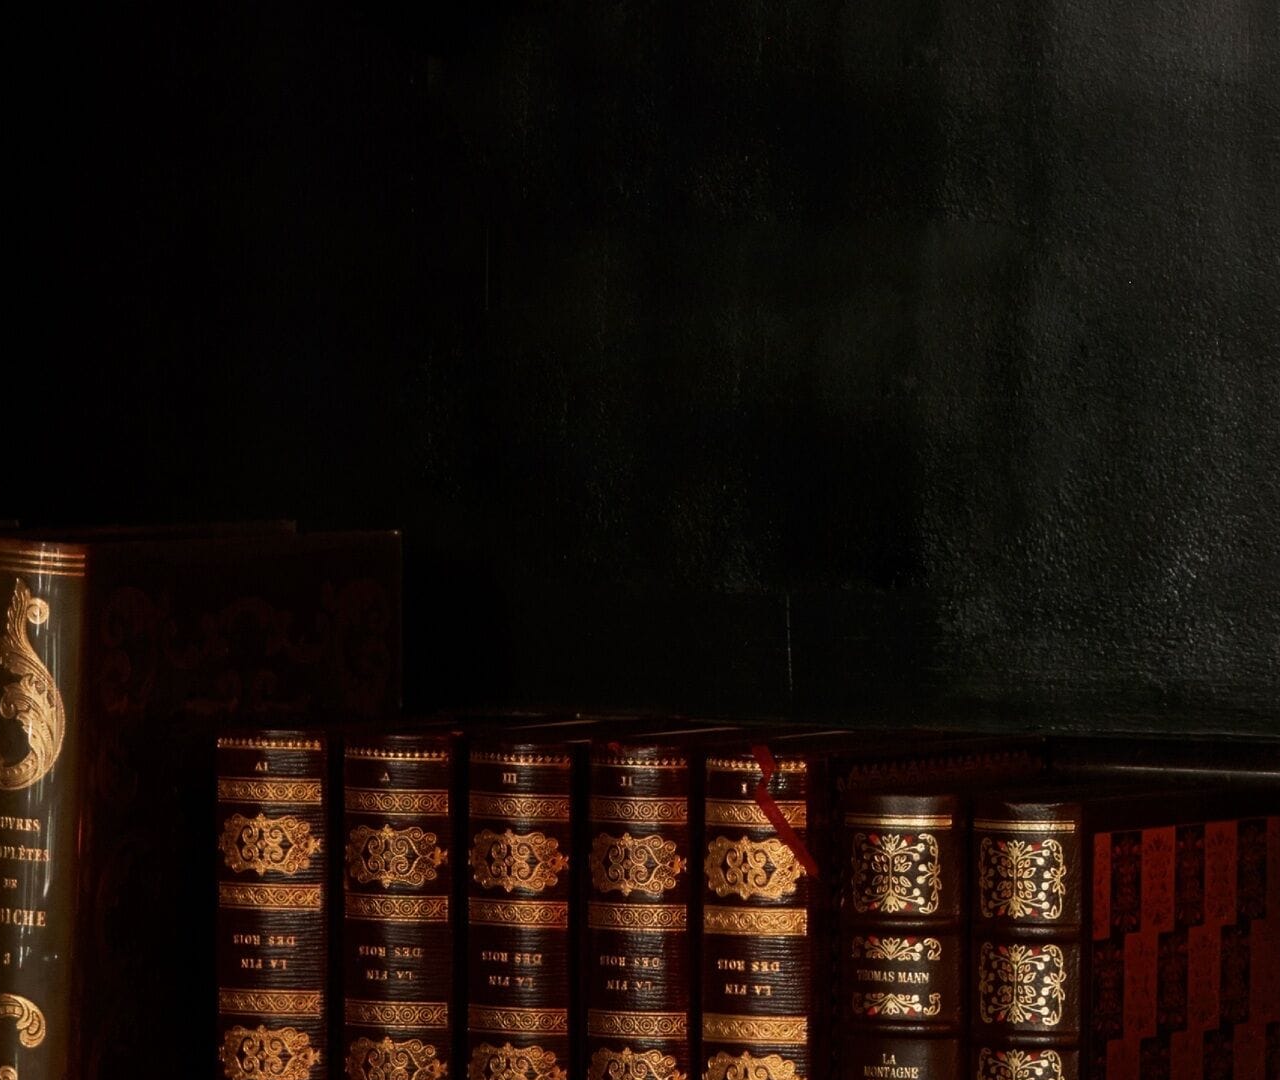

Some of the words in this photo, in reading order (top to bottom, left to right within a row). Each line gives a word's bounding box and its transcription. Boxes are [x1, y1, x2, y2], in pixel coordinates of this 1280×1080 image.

[502, 772, 518, 785] III
[620, 775, 633, 787] II
[232, 934, 260, 946] ROIS
[268, 935, 295, 947] DES
[358, 945, 386, 957] ROIS
[394, 946, 421, 958] DES
[481, 951, 508, 962] ROIS
[240, 958, 262, 969] FIN
[270, 958, 287, 970] LA
[515, 952, 543, 964] DES
[599, 955, 626, 967] ROIS
[634, 957, 660, 968] DES
[717, 959, 745, 971] ROIS
[752, 960, 780, 972] DES
[365, 969, 387, 980] FIN
[396, 970, 413, 980] LA
[488, 975, 510, 986] FIN
[856, 969, 895, 983] THOMAS
[897, 971, 929, 984] MANN
[516, 976, 534, 988] LA
[607, 979, 628, 990] FIN
[635, 980, 652, 991] LA
[724, 983, 747, 995] FIN
[753, 984, 772, 996] LA
[882, 1053, 897, 1065] LA
[864, 1065, 919, 1079] MONTAGNE
